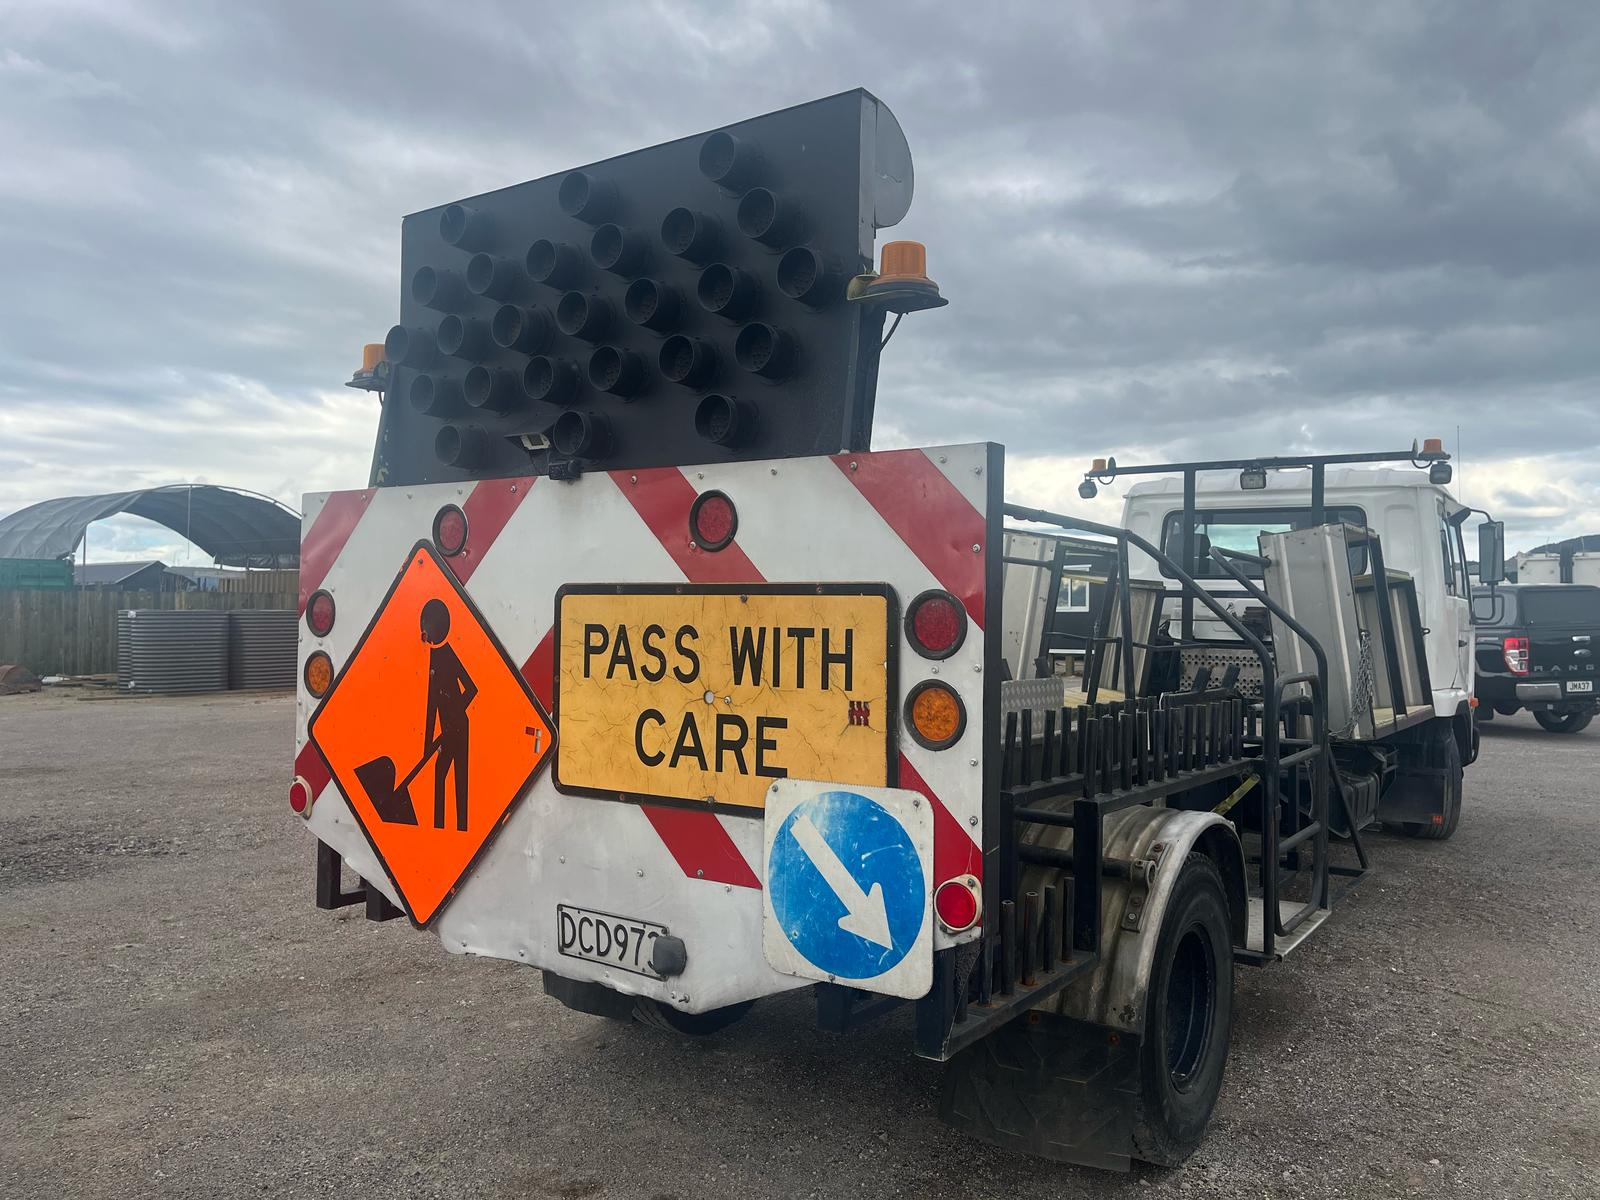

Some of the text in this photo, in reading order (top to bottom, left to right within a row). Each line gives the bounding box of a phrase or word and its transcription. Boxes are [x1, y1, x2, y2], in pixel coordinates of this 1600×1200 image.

[583, 623, 854, 691] PASS WITH
[634, 708, 788, 778] CARE
